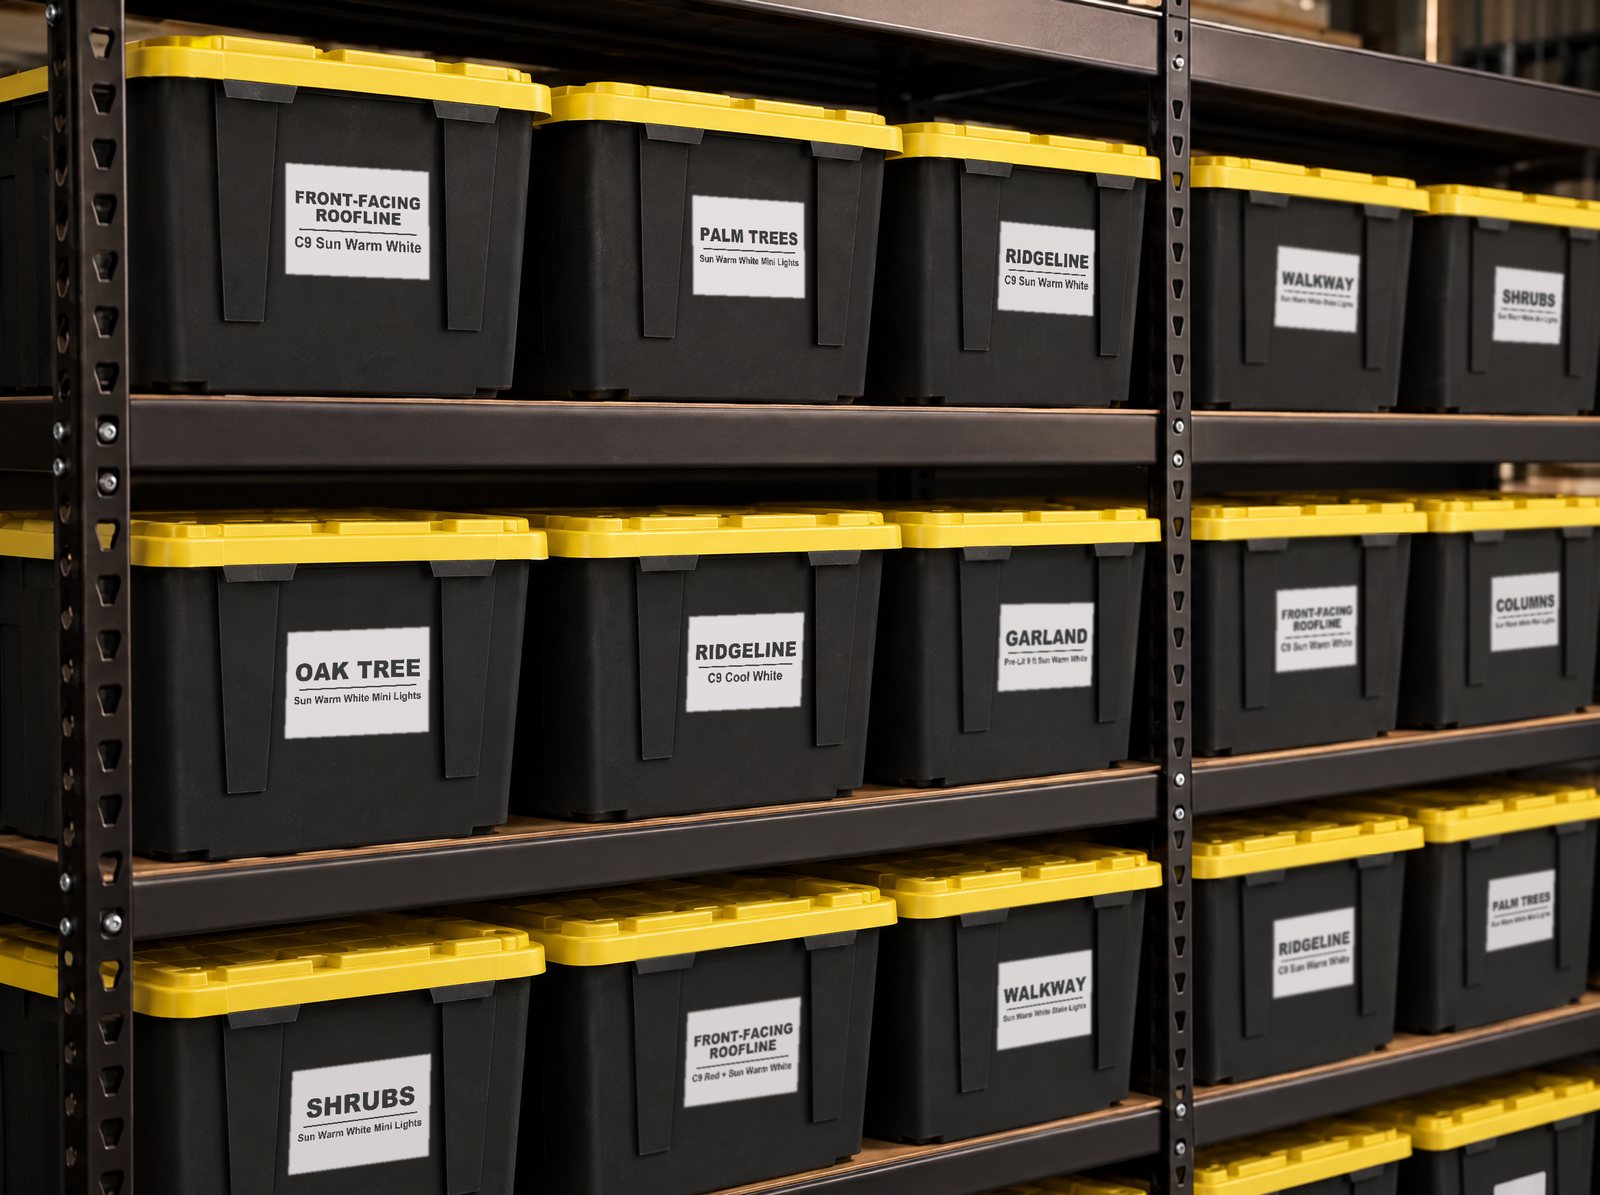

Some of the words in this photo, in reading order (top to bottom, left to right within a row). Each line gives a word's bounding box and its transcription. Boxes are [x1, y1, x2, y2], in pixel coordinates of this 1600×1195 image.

[295, 190, 421, 210] FRONT-FACING
[315, 209, 401, 226] ROOFLINE
[295, 236, 312, 249] C9
[316, 238, 341, 250] Sun
[345, 239, 382, 251] Warm
[387, 240, 421, 253] White
[700, 227, 744, 244] PALM
[749, 230, 798, 246] TREES
[699, 255, 714, 264] Sun
[716, 256, 737, 265] Warm
[739, 257, 759, 265] White
[761, 258, 776, 266] Mini
[777, 258, 799, 267] Lights
[1006, 249, 1089, 269] RIDGELINE
[1004, 275, 1016, 286] C9
[1019, 276, 1036, 287] Sun
[1038, 277, 1063, 289] Warm
[1065, 279, 1089, 291] White
[1282, 271, 1354, 291] WALKWAY
[1502, 289, 1556, 308] SHRUBS
[1281, 605, 1353, 620] FRONT-FACING
[1496, 594, 1555, 613] COLUMNS
[1293, 618, 1342, 632] ROOFLINE
[1006, 628, 1087, 646] GARLAND
[1293, 641, 1307, 651] Sun
[1309, 640, 1330, 650] Warm
[1332, 638, 1353, 648] White
[695, 641, 797, 661] RIDGELINE
[1038, 656, 1050, 664] Sun
[1071, 655, 1088, 663] White
[295, 661, 349, 681] OAK
[357, 659, 421, 678] TREE
[708, 672, 722, 683] C9
[725, 671, 750, 683] Cool
[753, 670, 783, 681] White
[294, 695, 312, 705] Sun
[315, 694, 341, 704] Warm
[343, 693, 370, 703] White
[372, 692, 391, 701] Mini
[394, 691, 421, 702] Lights
[1492, 896, 1519, 912] PALM
[1521, 891, 1551, 907] TREES
[1279, 931, 1350, 957] RIDGELINE
[1290, 963, 1305, 974] Sun
[1306, 960, 1328, 971] Warm
[1329, 955, 1350, 967] White
[1004, 976, 1086, 1004] WALKWAY
[1003, 1014, 1015, 1023] Sun
[1016, 1011, 1033, 1021] Warm
[1034, 1008, 1051, 1017] White
[1052, 1006, 1067, 1014] Stake
[1069, 1002, 1086, 1013] Lights
[694, 1023, 793, 1047] FRONT-FACING
[710, 1039, 776, 1060] ROOFLINE
[692, 1073, 703, 1082] C9
[704, 1071, 720, 1082] Red
[728, 1068, 743, 1078] Sun
[745, 1065, 768, 1077] Warm
[770, 1061, 792, 1072] White
[306, 1086, 415, 1118] SHRUBS
[297, 1133, 316, 1143] Sun
[318, 1129, 344, 1140] Warm
[346, 1126, 371, 1136] White
[374, 1122, 393, 1132] Mini
[395, 1119, 422, 1132] Lights
